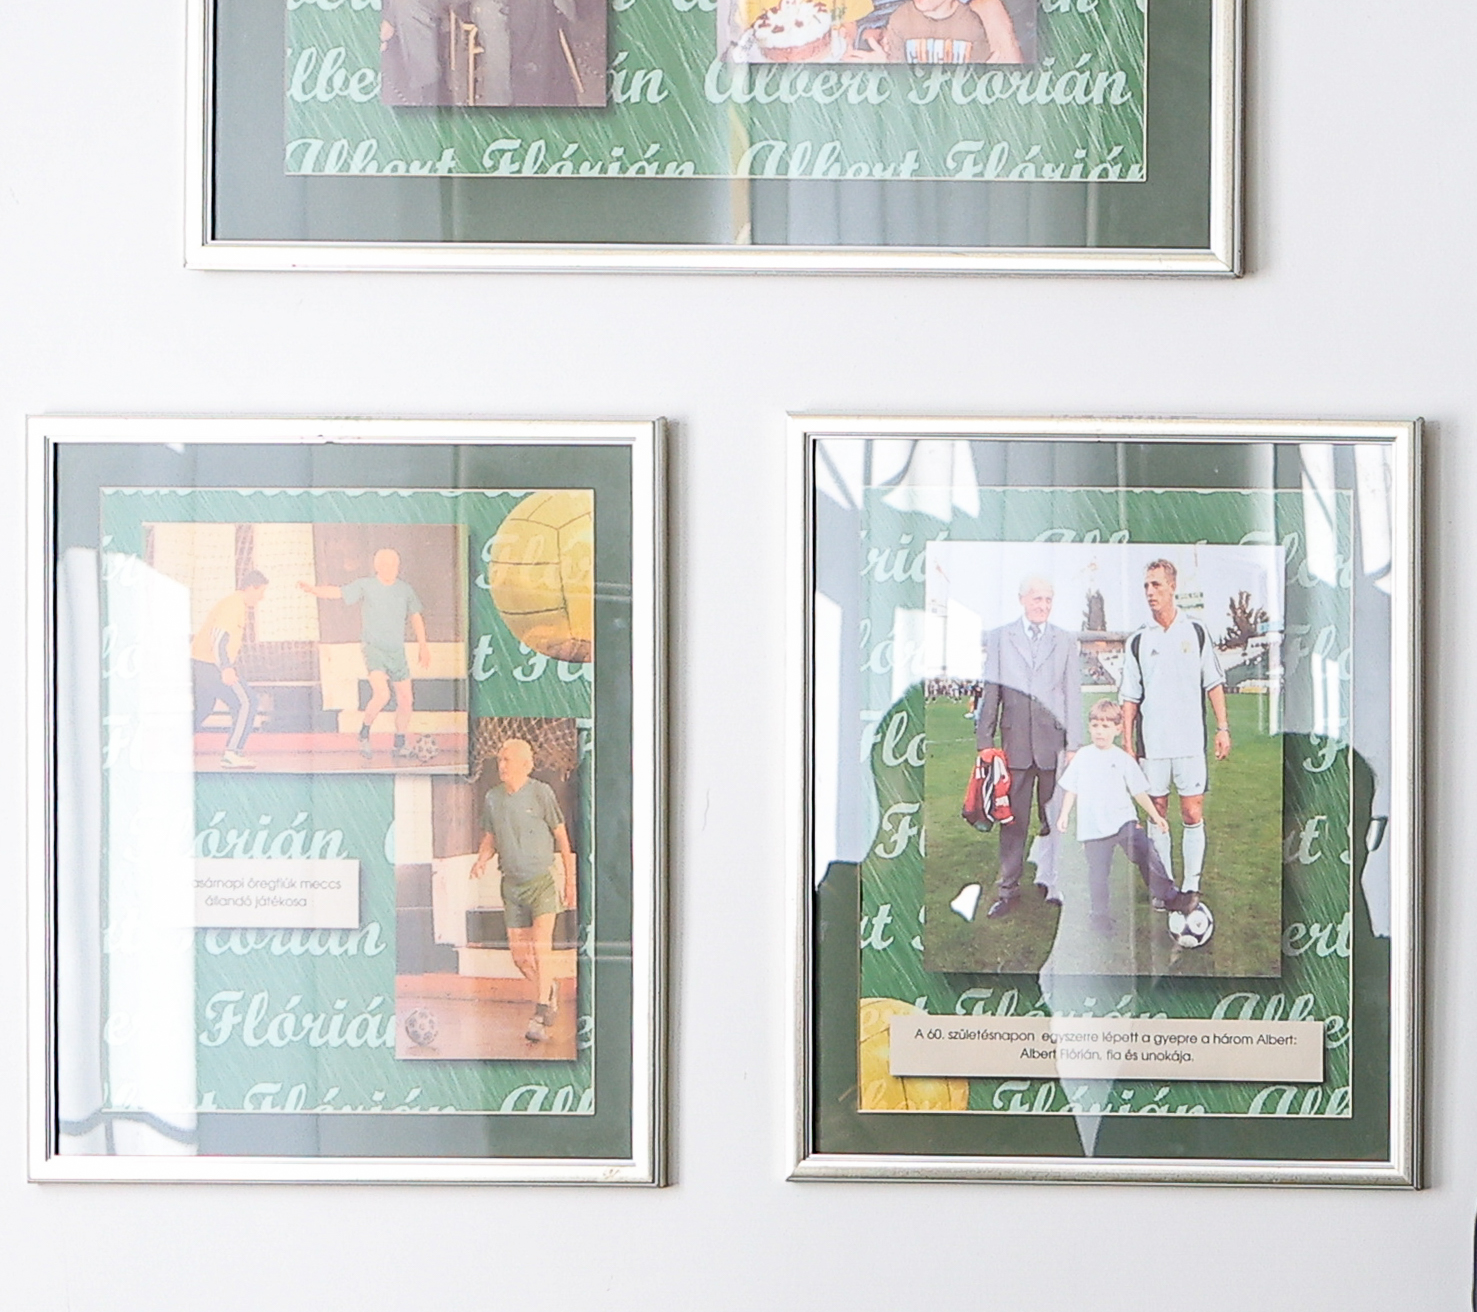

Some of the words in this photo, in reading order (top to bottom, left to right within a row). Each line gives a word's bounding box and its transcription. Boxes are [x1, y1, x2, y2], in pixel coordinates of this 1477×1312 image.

[914, 1029, 924, 1040] A
[927, 1029, 945, 1041] 60.
[948, 1028, 1034, 1043] születésnapon
[1102, 1031, 1138, 1044] lépett
[1141, 1034, 1150, 1043] a
[1153, 1034, 1197, 1046] gyepre
[1200, 1035, 1210, 1044] a
[1212, 1033, 1253, 1044] három
[1256, 1034, 1296, 1045] Albert:
[1020, 1048, 1056, 1059] Albert
[1106, 1049, 1121, 1060] fia
[1124, 1049, 1138, 1060] és
[1141, 1049, 1194, 1064] unokája.
